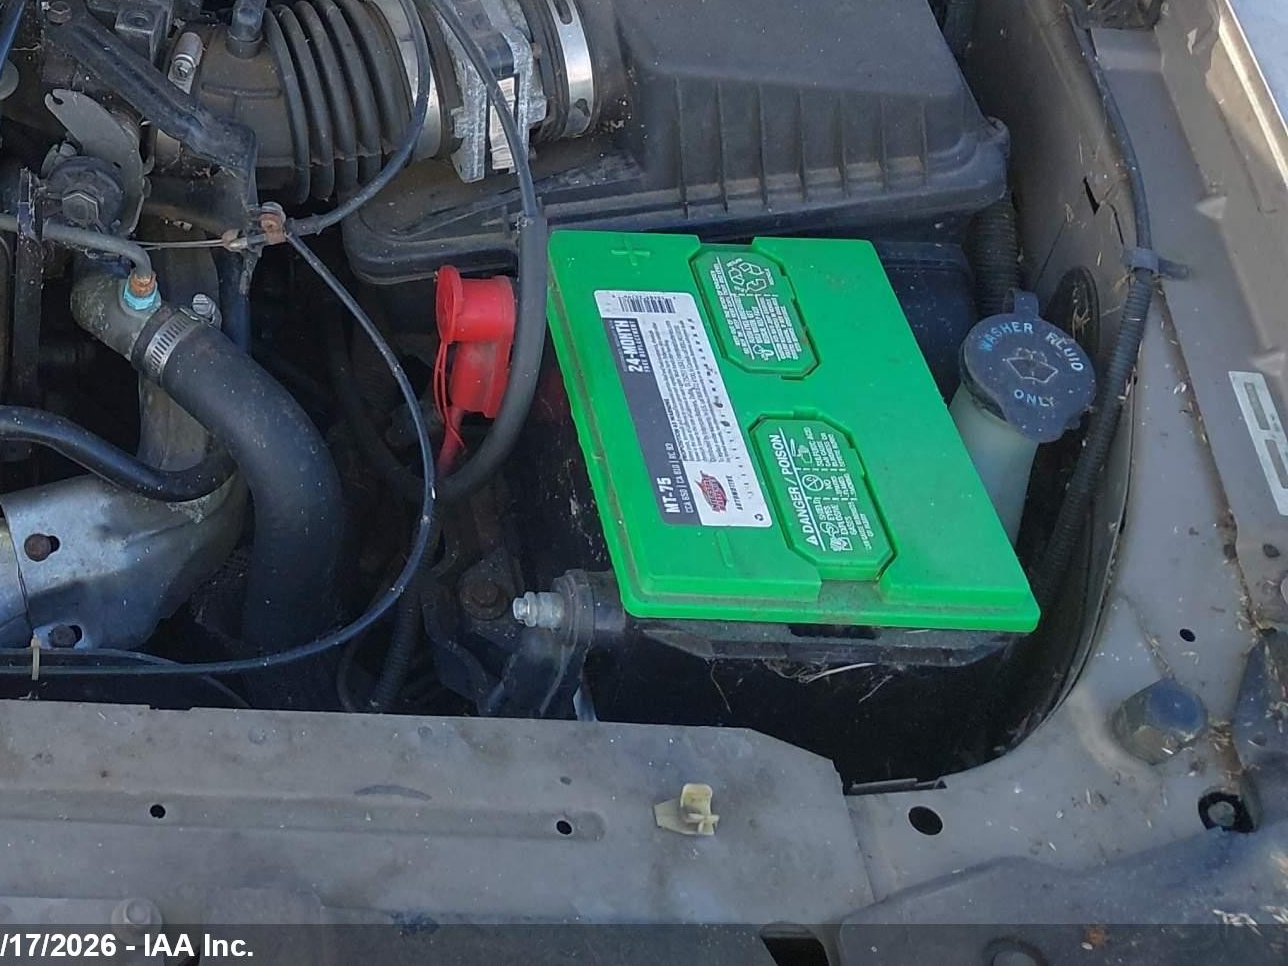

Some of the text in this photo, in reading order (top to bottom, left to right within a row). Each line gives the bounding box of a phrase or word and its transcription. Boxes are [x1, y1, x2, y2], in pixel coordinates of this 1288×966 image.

[614, 320, 643, 372] 24-MONTH
[978, 321, 1084, 371] WASHER FLUID
[1013, 389, 1054, 407] ONLY
[769, 434, 792, 474] POISON
[675, 475, 684, 483] CA
[823, 479, 832, 489] NO
[657, 477, 681, 513] MT-75
[725, 476, 743, 510] AUTOMOTIVE
[684, 501, 694, 513] CCA
[788, 486, 813, 532] DANGER
[812, 497, 826, 520] SHIELD
[823, 505, 834, 520] EYES
[844, 515, 857, 535] GASES
